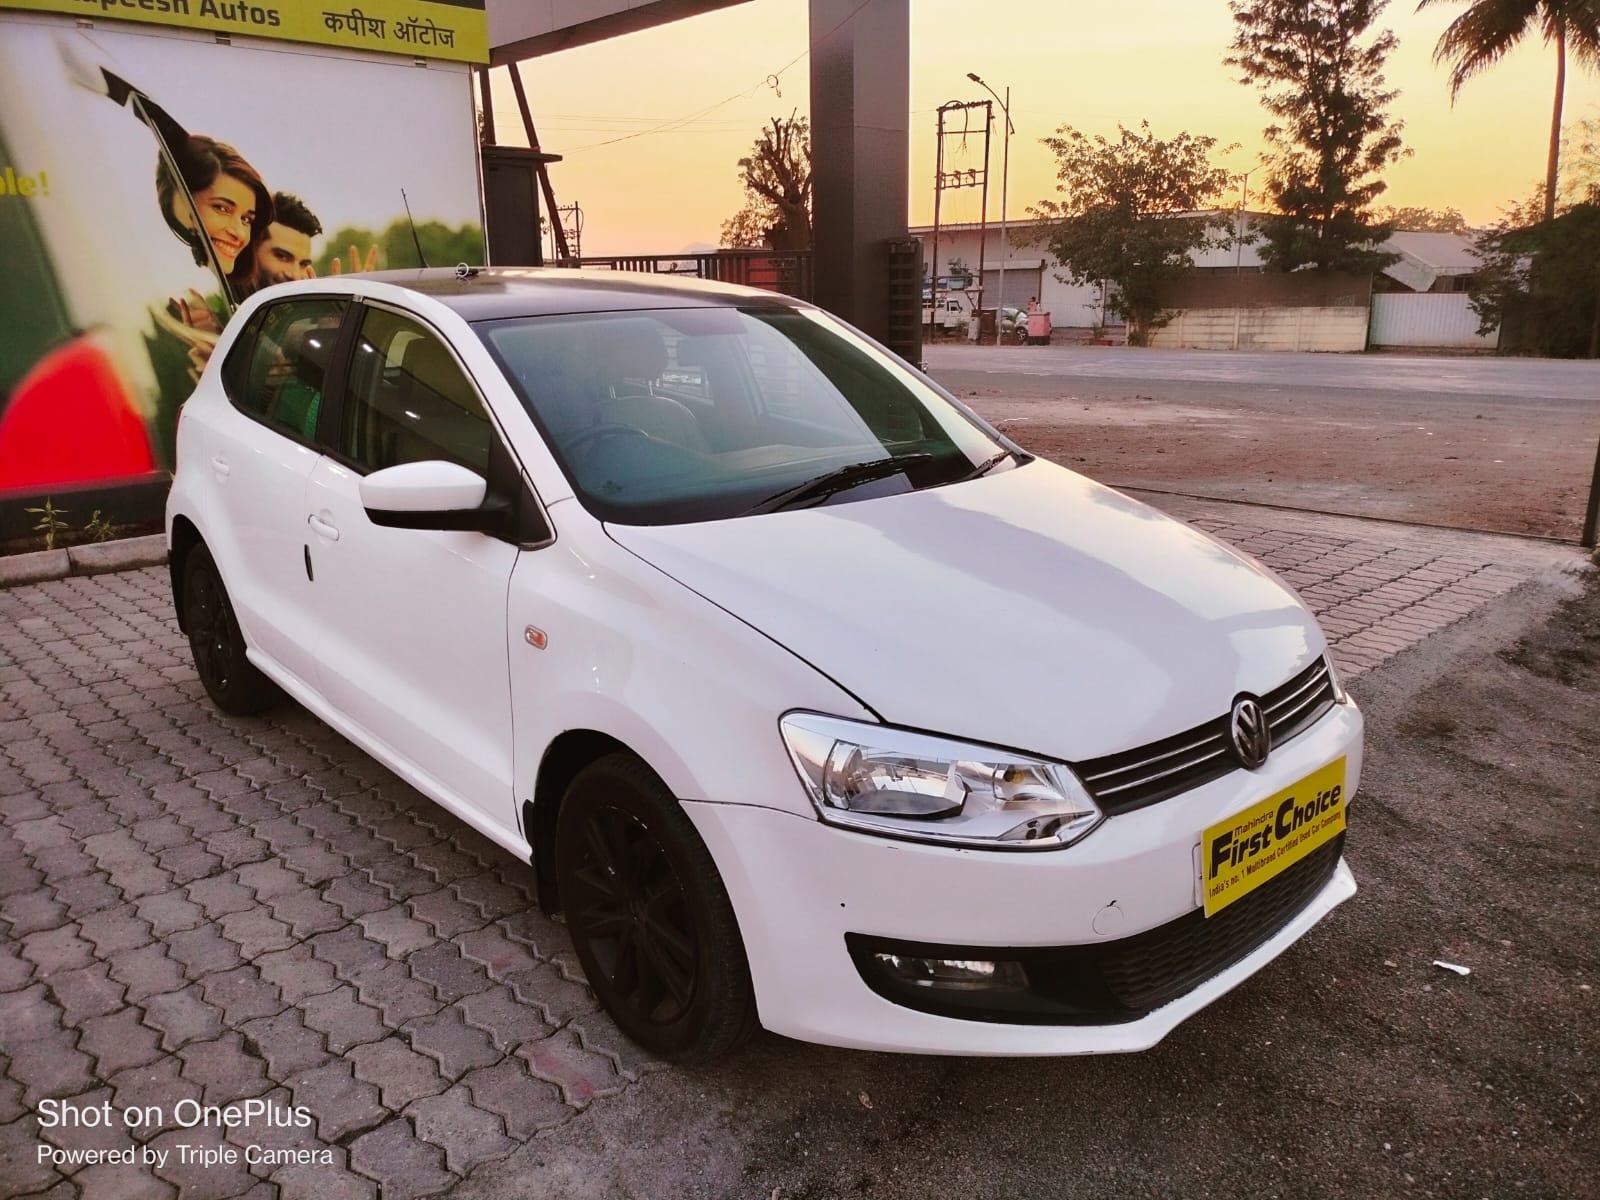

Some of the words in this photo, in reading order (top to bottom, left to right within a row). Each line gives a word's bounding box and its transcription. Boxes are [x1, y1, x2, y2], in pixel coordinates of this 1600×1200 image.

[200, 0, 281, 27] Autos
[322, 8, 386, 39] कपीश
[393, 16, 455, 48] ऑटोज
